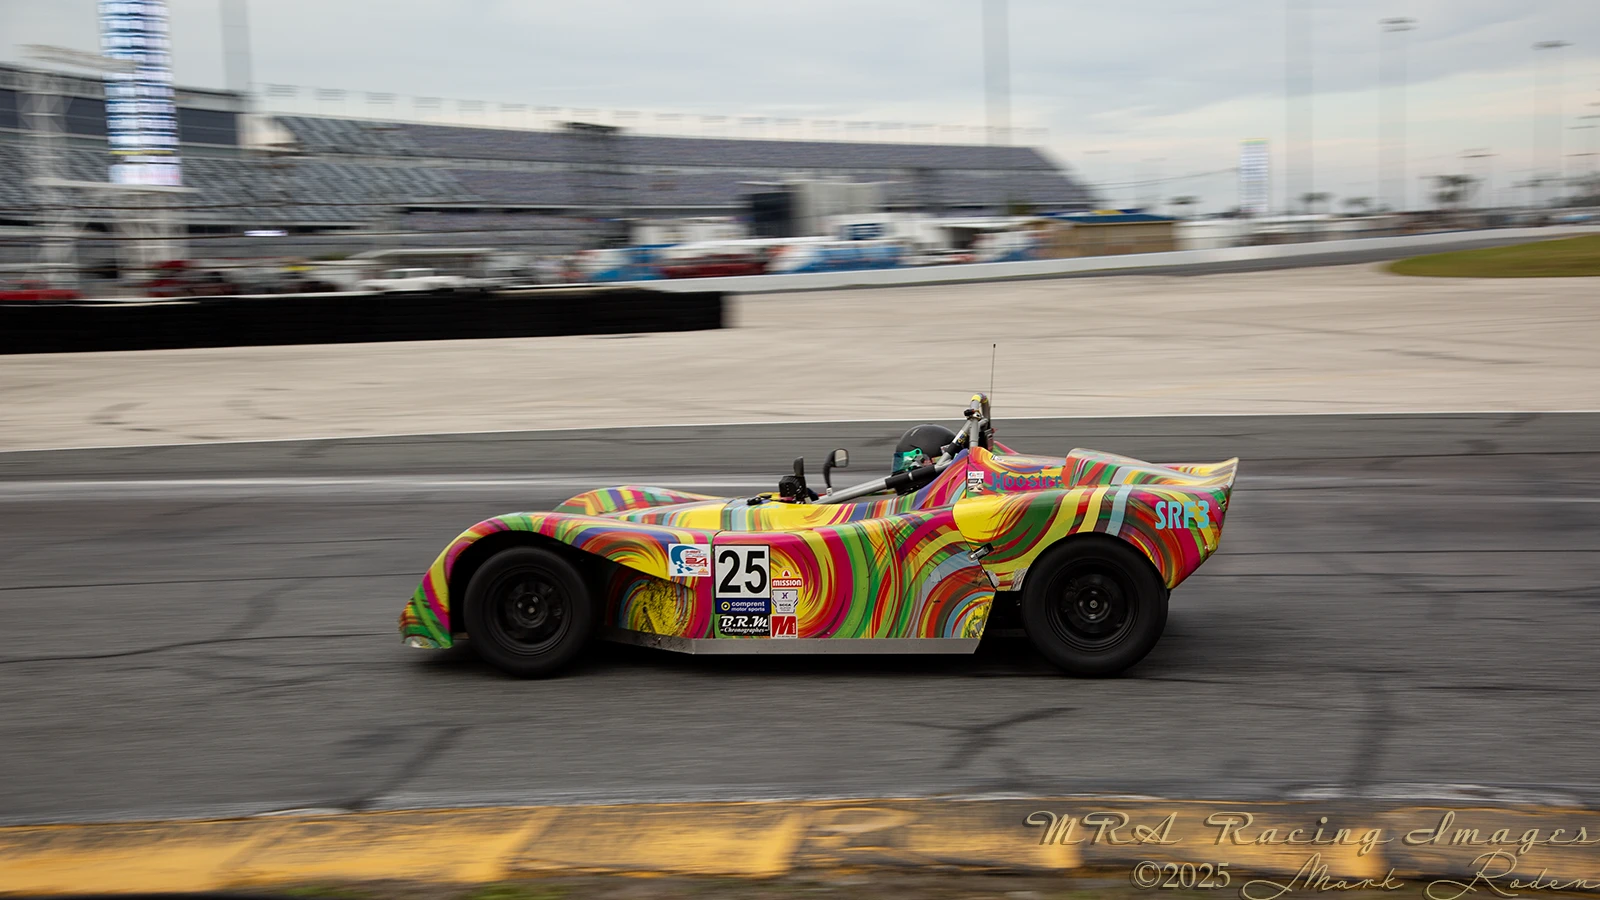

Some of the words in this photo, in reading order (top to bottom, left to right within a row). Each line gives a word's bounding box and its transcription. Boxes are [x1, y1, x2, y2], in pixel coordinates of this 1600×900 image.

[988, 471, 1063, 491] Hoosier
[1155, 499, 1210, 531] SRF3
[718, 549, 768, 594] 25
